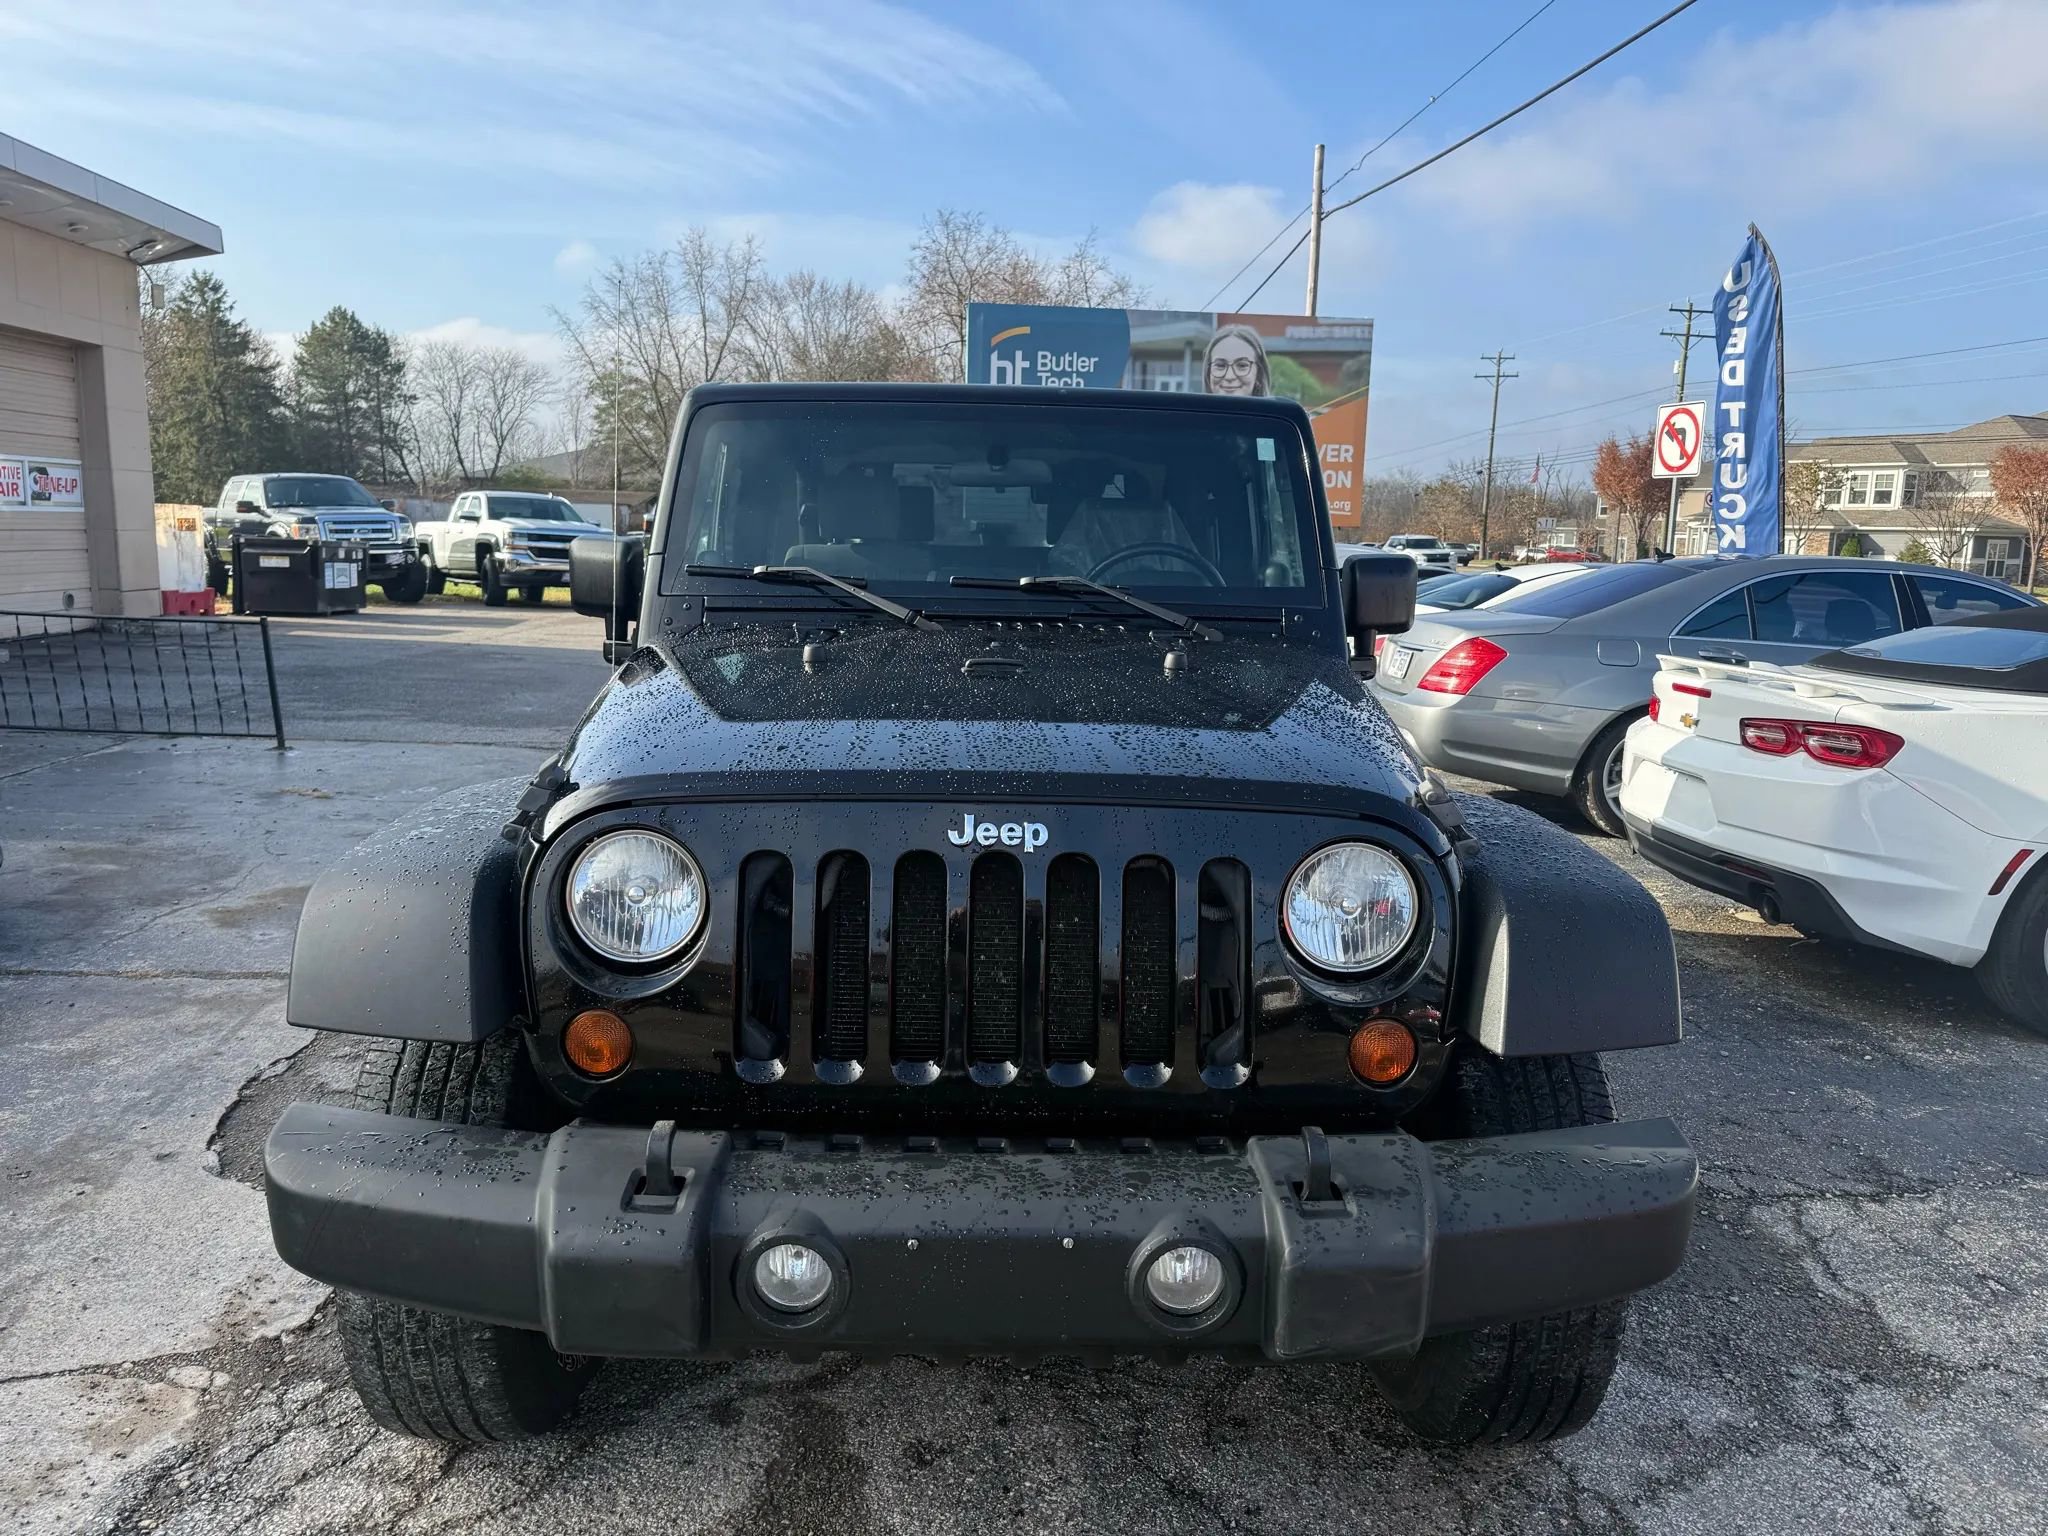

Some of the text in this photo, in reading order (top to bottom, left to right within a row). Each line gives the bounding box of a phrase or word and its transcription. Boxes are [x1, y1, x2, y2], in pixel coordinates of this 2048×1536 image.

[1037, 351, 1099, 372] Butler
[1037, 372, 1085, 388] Tech
[0, 465, 21, 480] TIVE
[37, 475, 78, 493] TUNE-UP
[1328, 501, 1351, 512] .org
[947, 813, 1049, 853] Jeep
